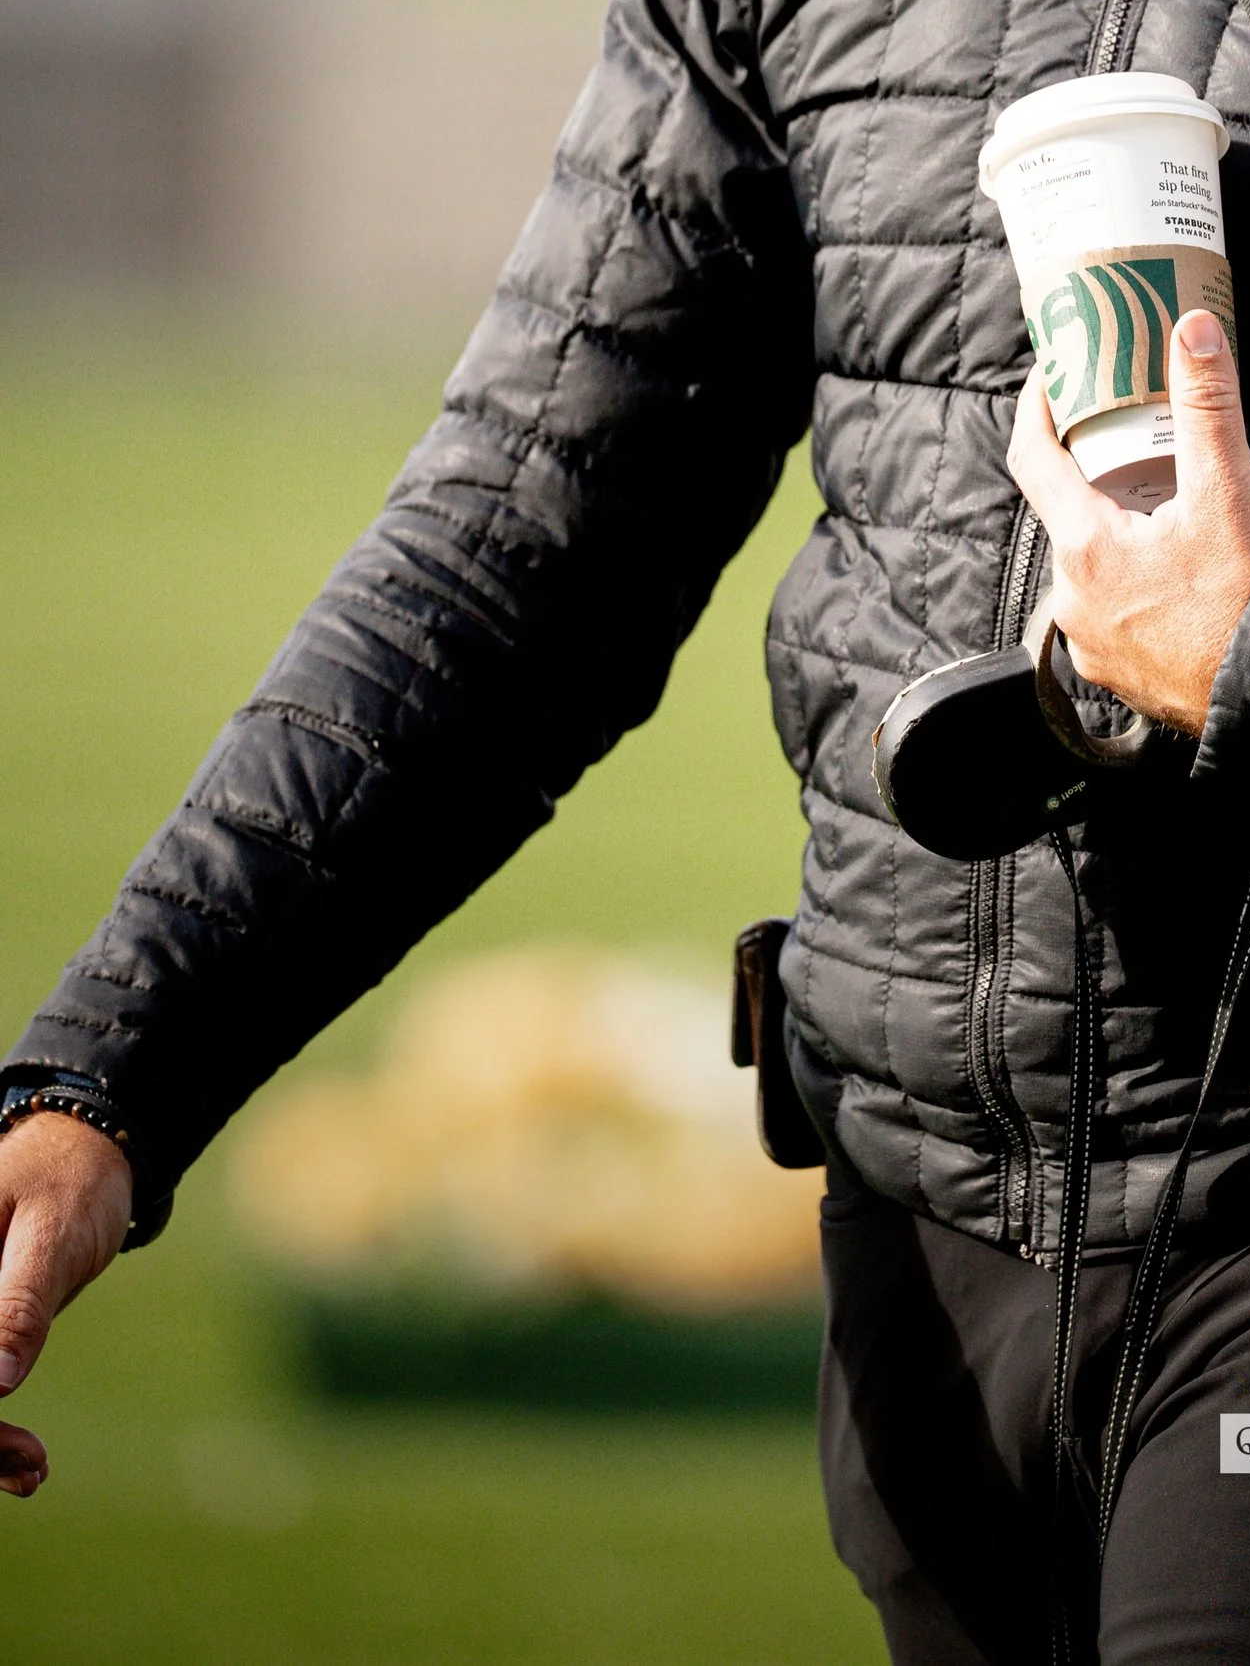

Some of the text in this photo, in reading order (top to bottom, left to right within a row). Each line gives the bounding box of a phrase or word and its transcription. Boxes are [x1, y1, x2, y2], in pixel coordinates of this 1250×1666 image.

[1045, 169, 1092, 186] Americano
[1160, 161, 1208, 181] That first
[1159, 179, 1177, 194] sip
[1151, 199, 1166, 207] Join
[1174, 227, 1211, 240] REWARDS
[1202, 284, 1218, 295] VOUS
[1203, 294, 1219, 305] VOUS
[1061, 781, 1086, 801] alcott
